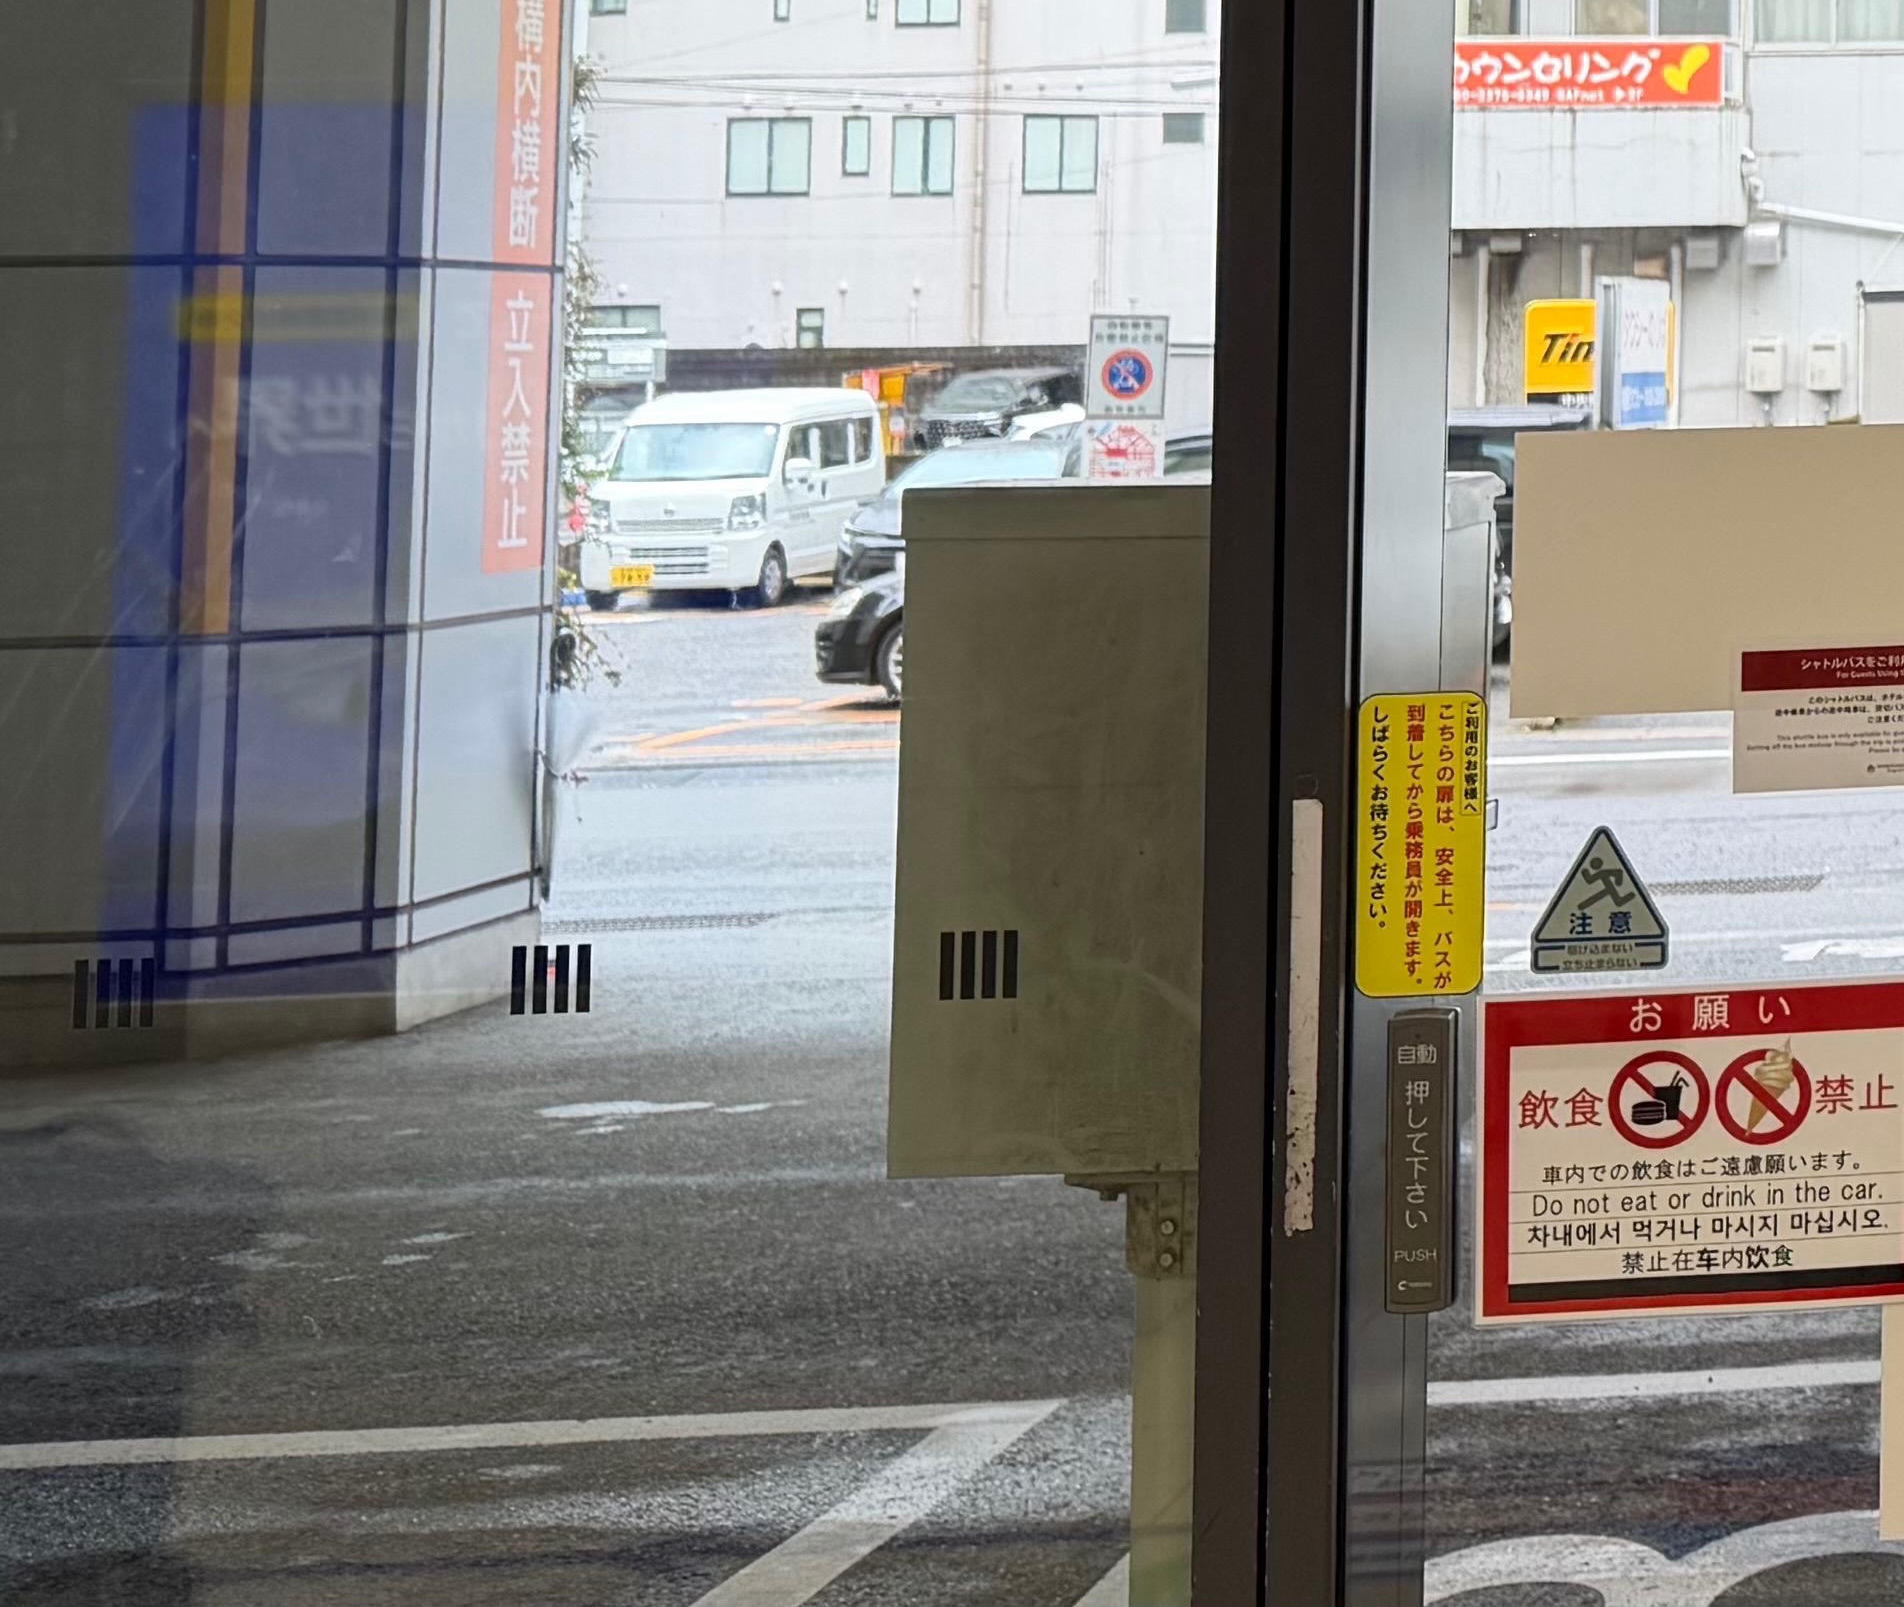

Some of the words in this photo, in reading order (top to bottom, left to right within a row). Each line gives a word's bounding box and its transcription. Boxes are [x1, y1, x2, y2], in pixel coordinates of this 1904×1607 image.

[496, 290, 535, 550] 立入禁止
[1463, 701, 1482, 814] ご利用のお客様へ
[1368, 705, 1391, 930] しばらくお待ちください。
[1403, 703, 1426, 986] 到着してから乗務員が開きます。
[1433, 703, 1456, 991] こちらの扉は、安全上、バスが
[1568, 910, 1633, 935] 注意
[1627, 992, 1794, 1035] お願い
[1397, 1044, 1438, 1065] 自動
[1517, 1087, 1606, 1130] 飲食
[1813, 1072, 1899, 1116] 禁止
[1404, 1079, 1430, 1230] 押して下さい
[1541, 1149, 1864, 1186] 車内での飲食はご遠慮願います。
[1532, 1192, 1564, 1217] Do
[1573, 1194, 1610, 1216] not
[1620, 1192, 1659, 1214] eat
[1668, 1193, 1690, 1212] or
[1702, 1185, 1756, 1209] drink
[1766, 1183, 1785, 1205] in
[1794, 1181, 1831, 1204] the
[1842, 1181, 1884, 1202] car.
[1526, 1221, 1623, 1248] 차내에서
[1632, 1217, 1702, 1243] 먹거나
[1711, 1213, 1779, 1239] 마시지
[1789, 1208, 1890, 1237] 마십시오.
[1394, 1248, 1438, 1263] PUSH
[1621, 1244, 1795, 1276] 禁止在车内饮食
